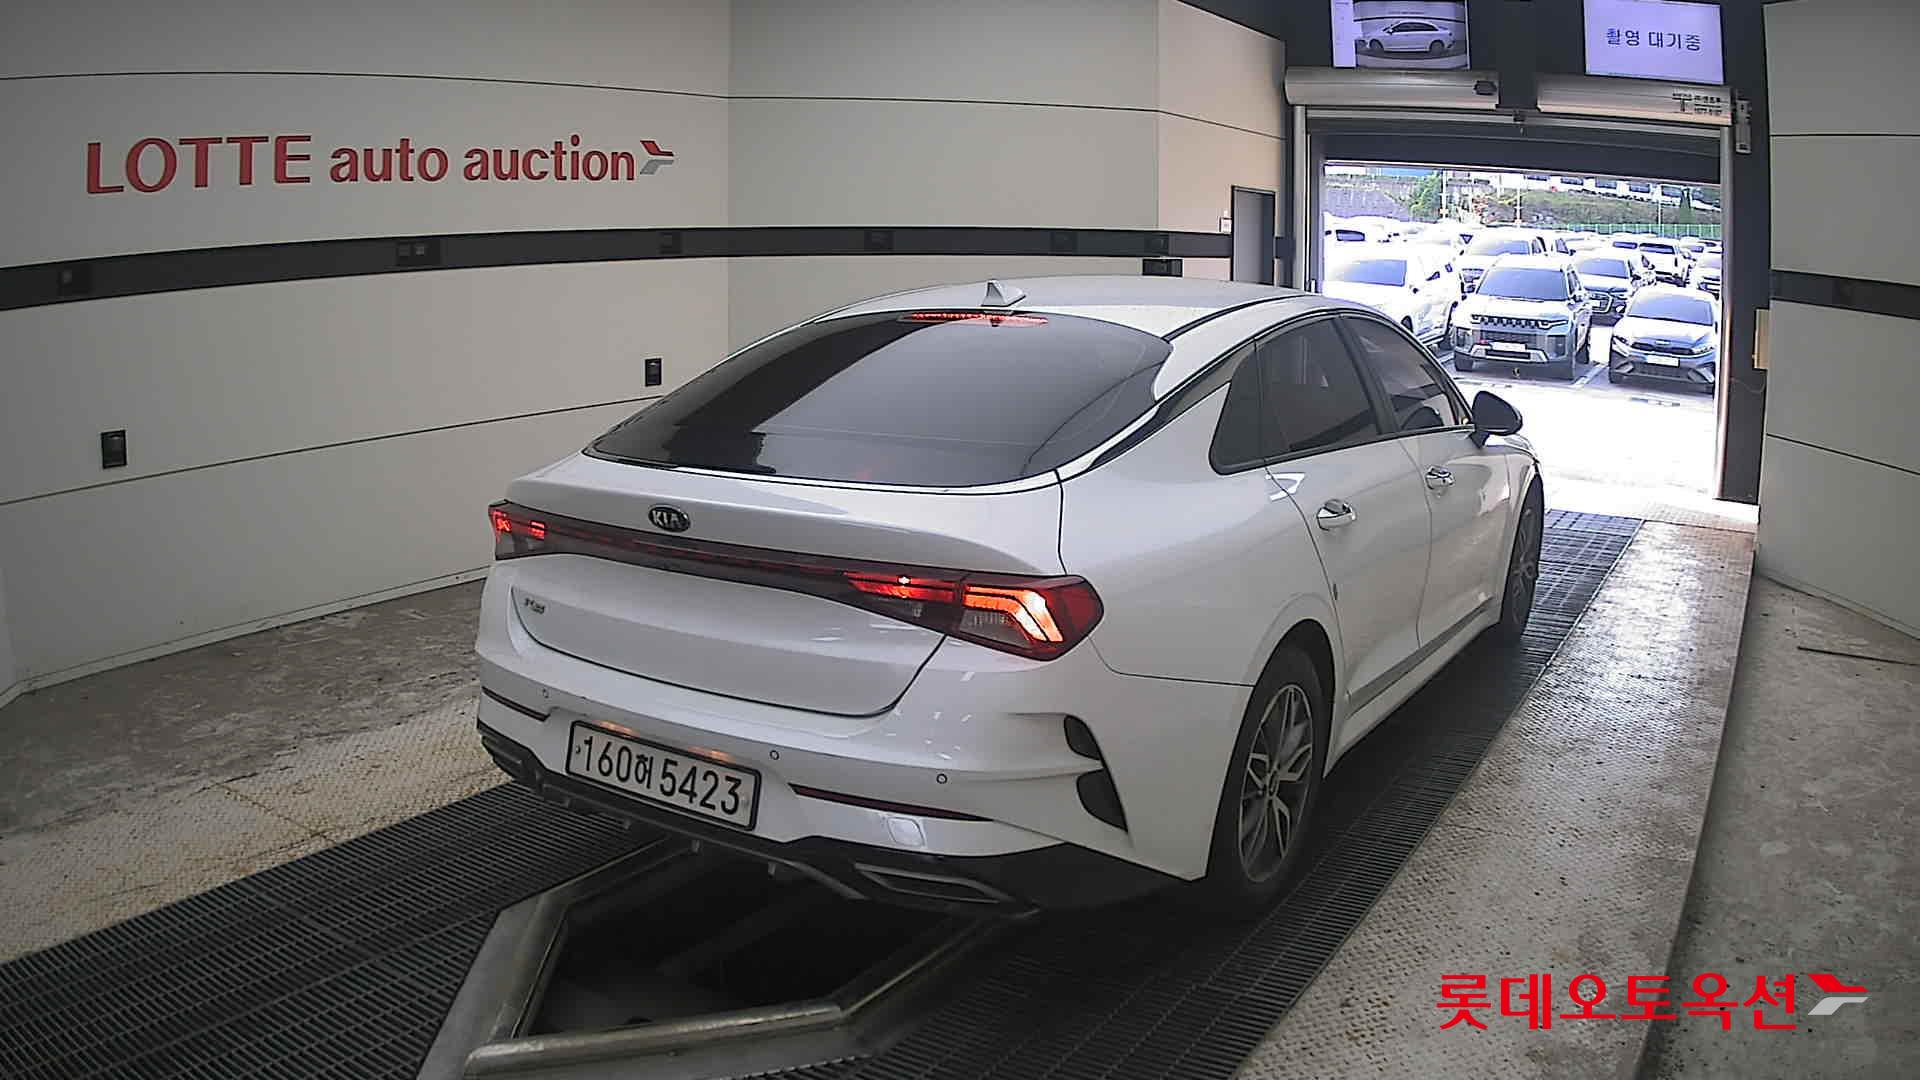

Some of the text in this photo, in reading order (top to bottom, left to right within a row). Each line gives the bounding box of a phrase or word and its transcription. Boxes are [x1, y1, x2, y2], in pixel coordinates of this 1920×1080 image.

[1606, 28, 1701, 52] 촬영 대기중
[87, 134, 636, 194] LOTTE auto auction
